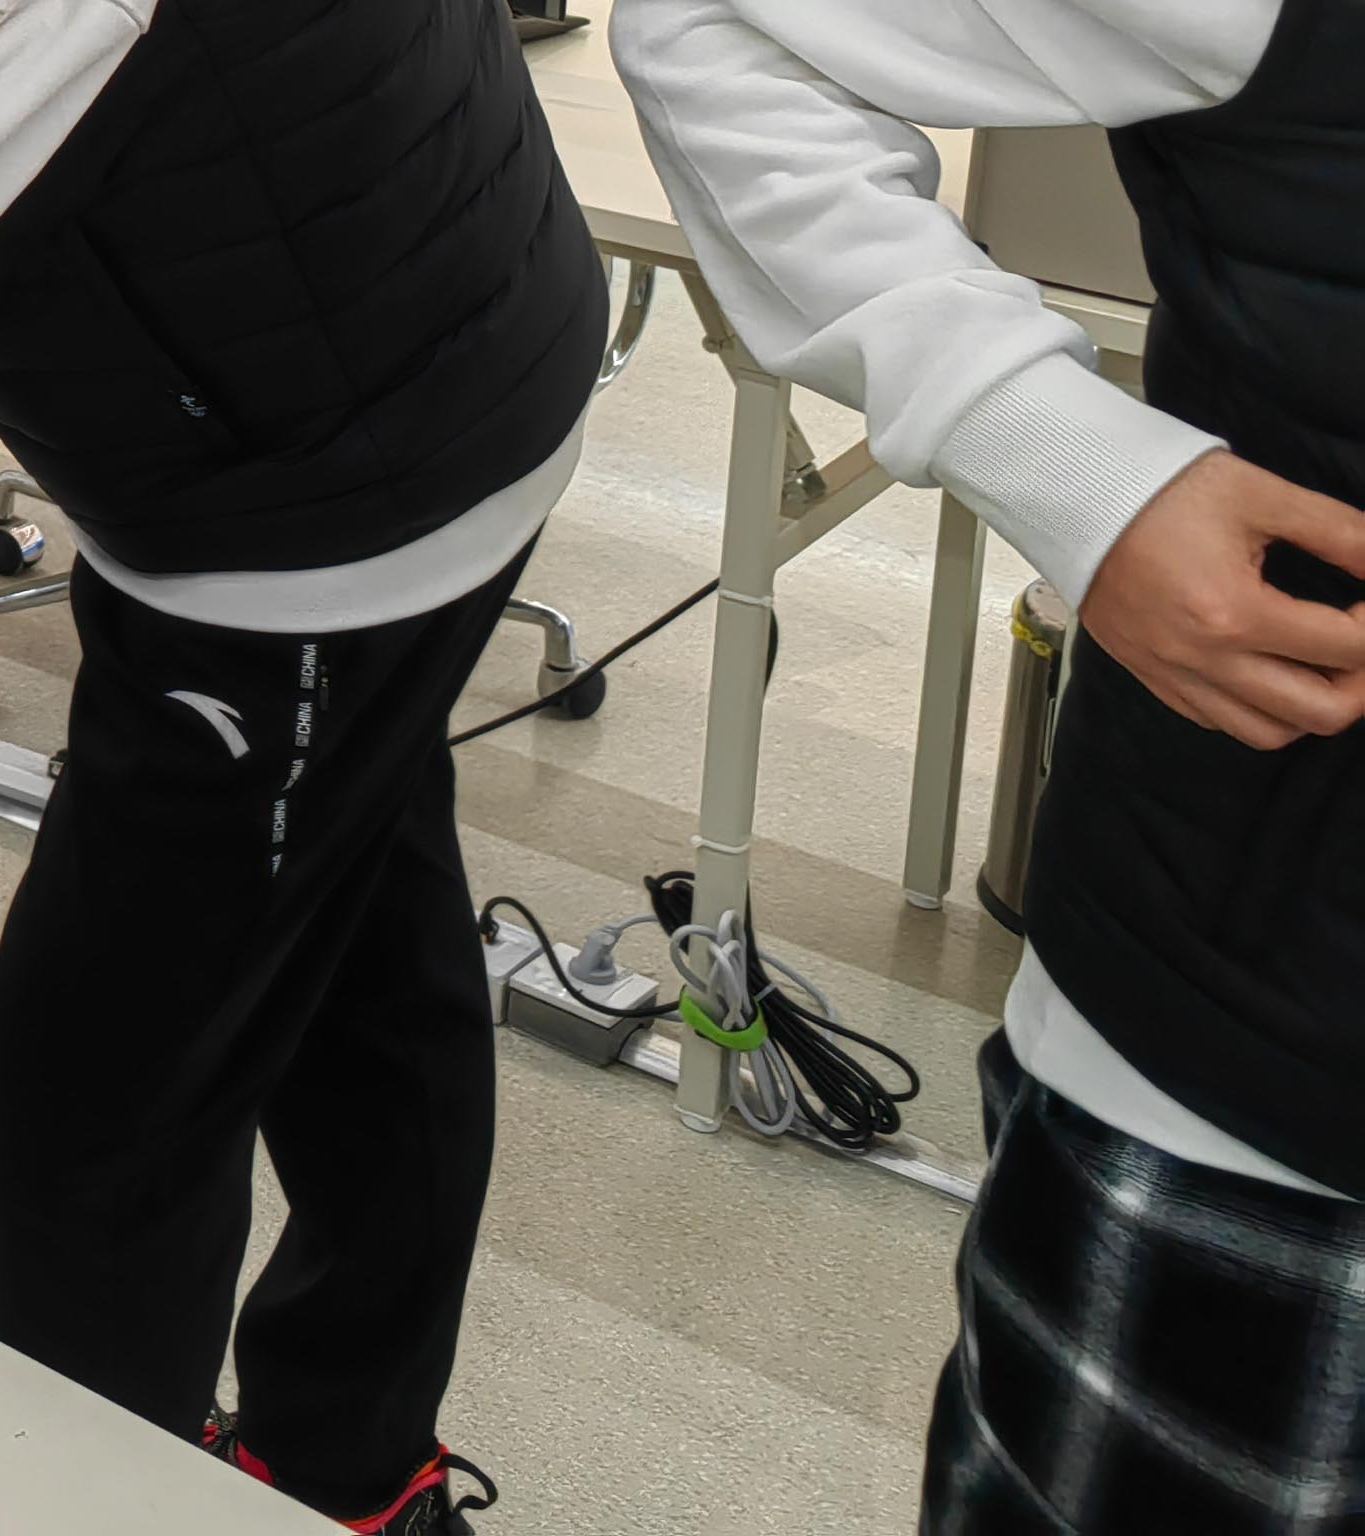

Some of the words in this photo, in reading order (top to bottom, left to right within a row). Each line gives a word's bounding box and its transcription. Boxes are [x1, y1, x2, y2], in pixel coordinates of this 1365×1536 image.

[301, 644, 317, 676] CHINA
[296, 703, 312, 734] CHINA
[273, 799, 286, 831] CHINA
